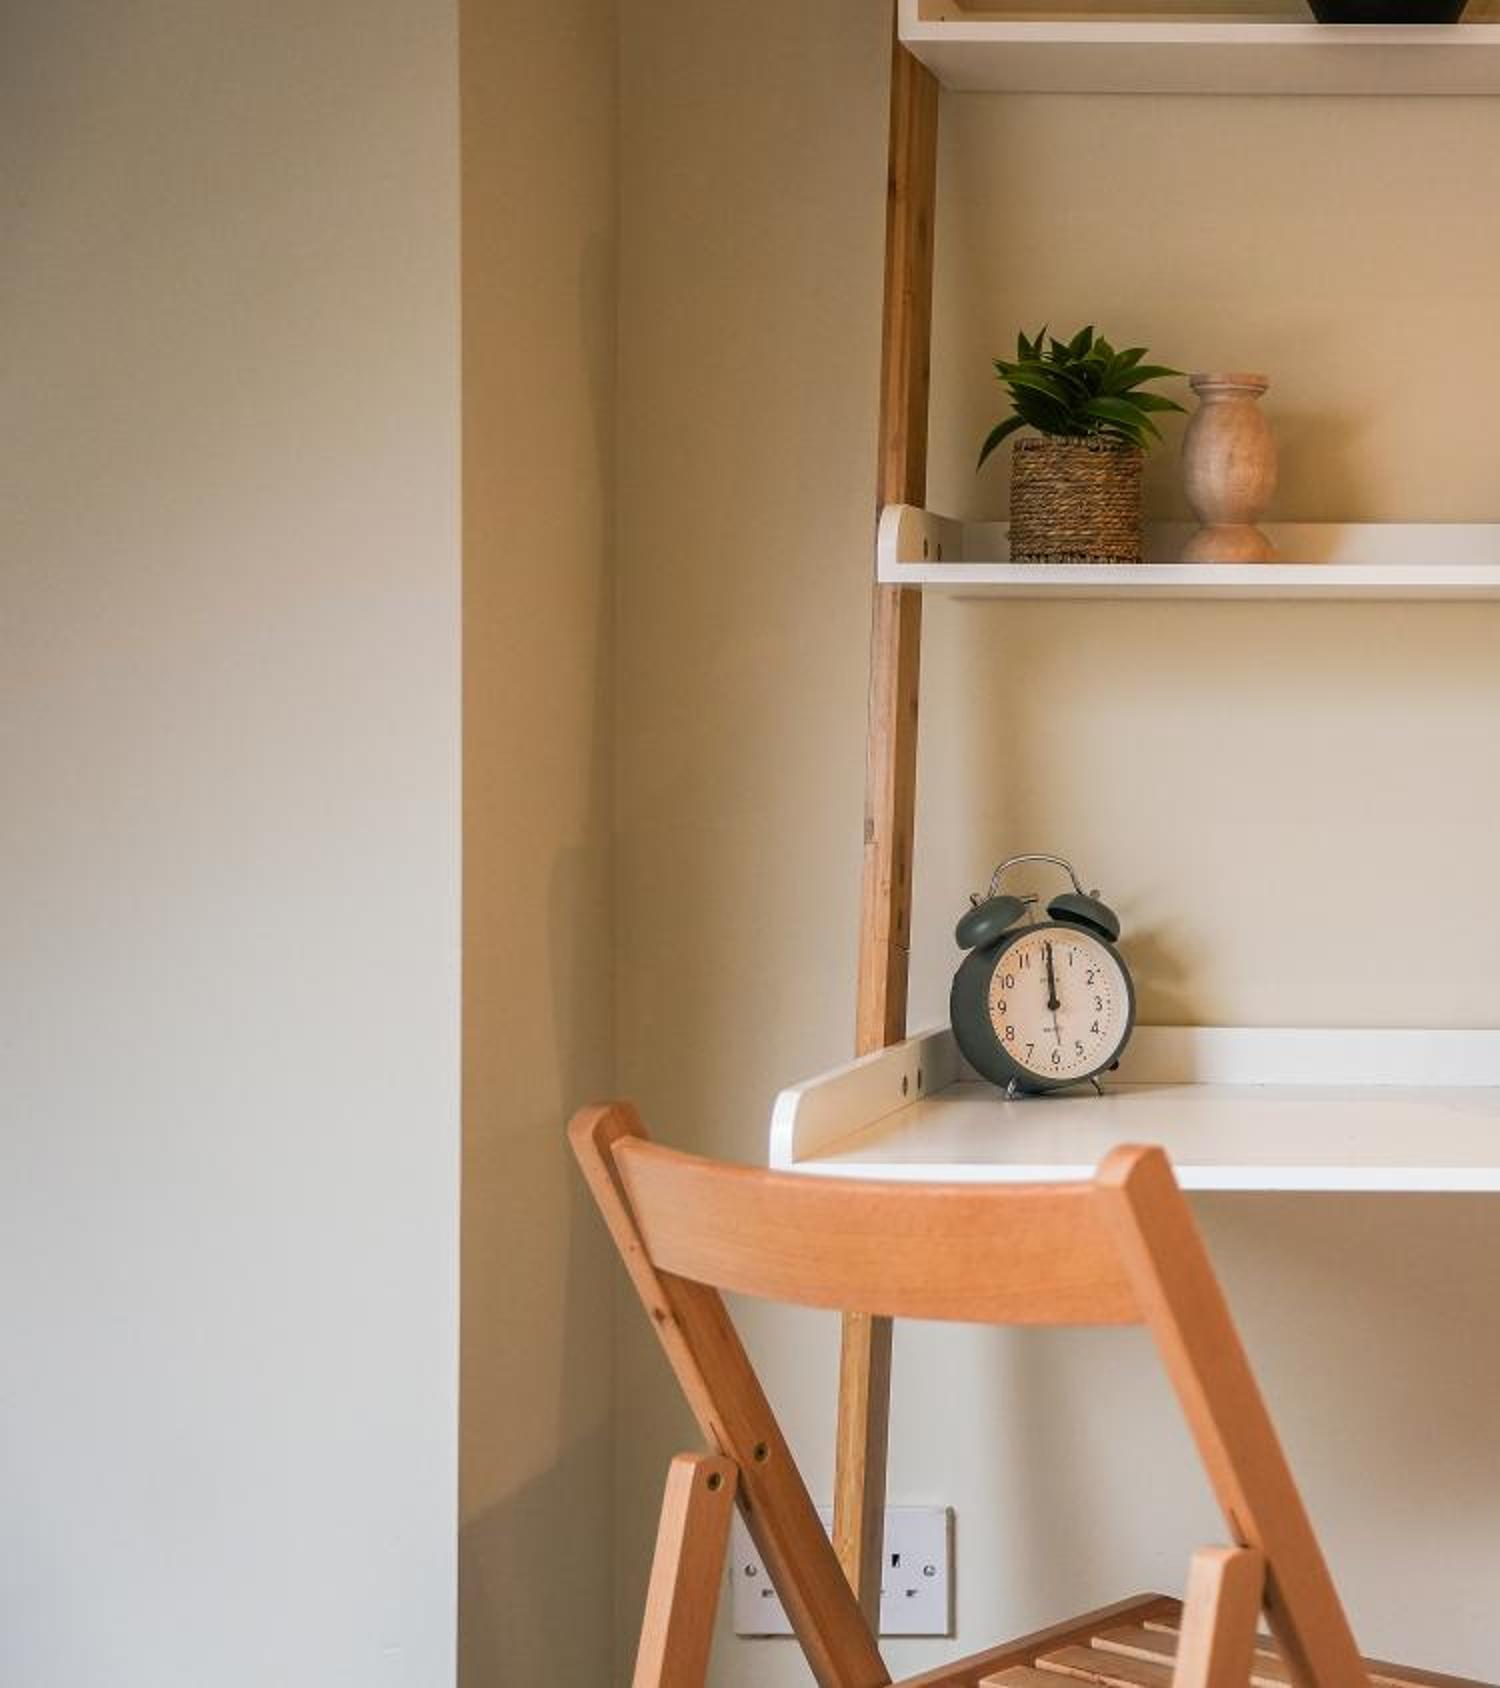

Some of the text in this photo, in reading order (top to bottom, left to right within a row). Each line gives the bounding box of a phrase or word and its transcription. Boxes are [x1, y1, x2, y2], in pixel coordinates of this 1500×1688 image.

[1020, 953, 1031, 969] 11
[1001, 973, 1015, 990] 10
[1086, 969, 1096, 985] 2
[997, 999, 1007, 1014] 9
[1095, 995, 1103, 1012] 3
[1005, 1025, 1015, 1041] 8
[1089, 1020, 1100, 1035] 4
[1026, 1042, 1035, 1059] 7
[1051, 1048, 1061, 1065] 6
[1075, 1041, 1084, 1056] 5
